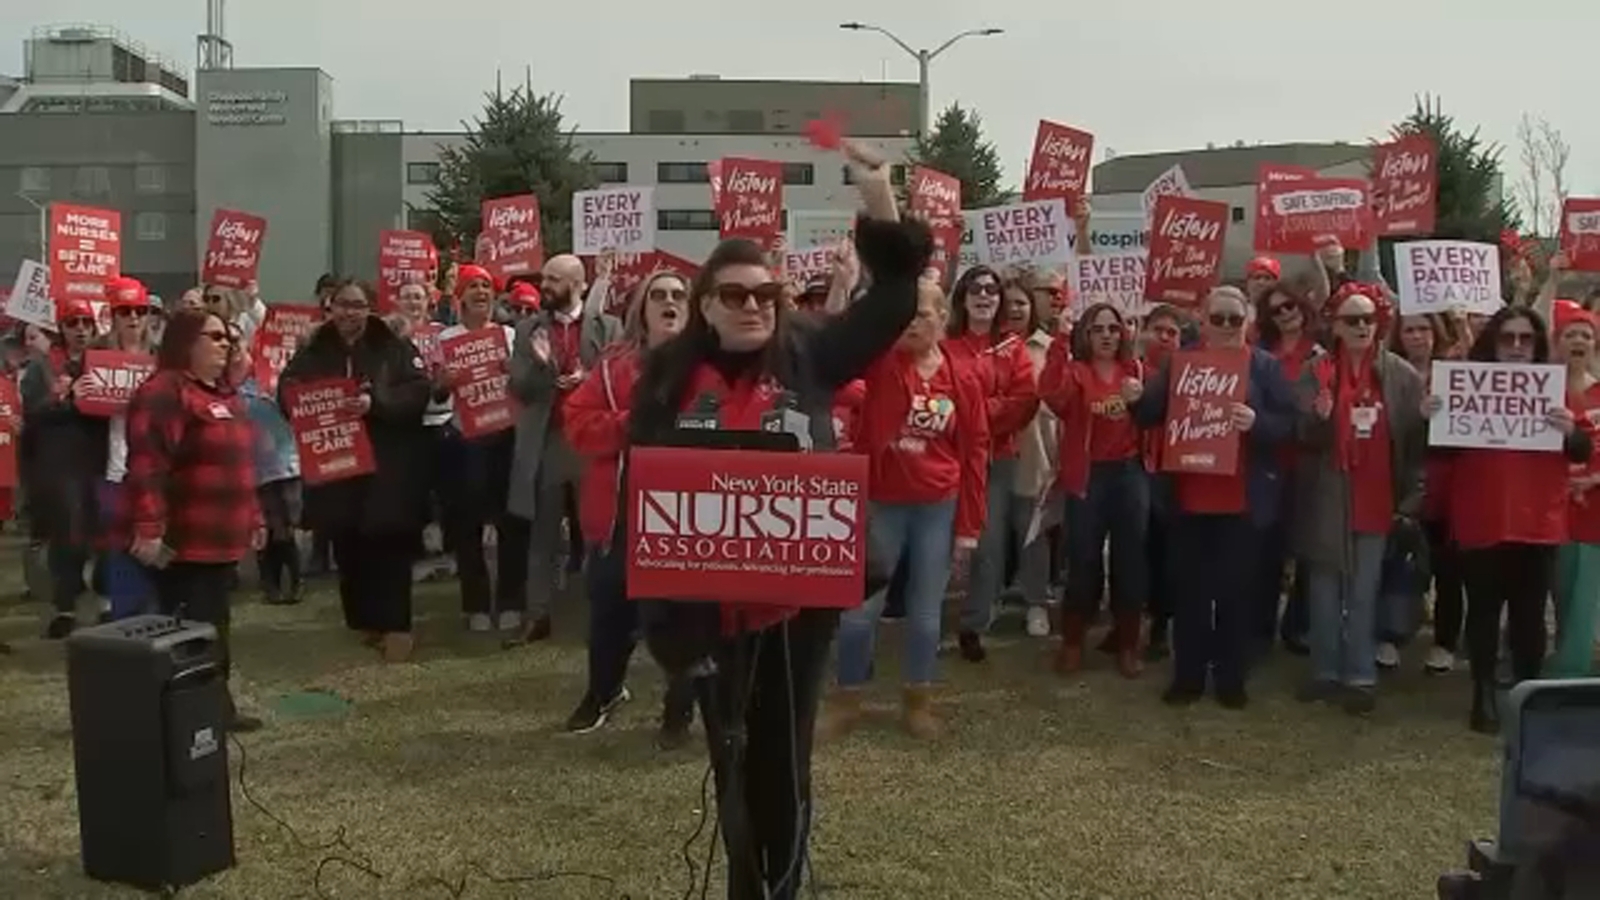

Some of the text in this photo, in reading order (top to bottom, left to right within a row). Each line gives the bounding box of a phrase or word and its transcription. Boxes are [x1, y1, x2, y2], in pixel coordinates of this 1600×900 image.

[584, 193, 641, 213] EVERY
[66, 213, 109, 228] MORE
[584, 212, 643, 230] PATIENT
[984, 205, 1053, 230] EVERY
[57, 223, 118, 241] NURSES
[612, 229, 642, 245] VIP
[987, 224, 1056, 245] PATIENT
[58, 249, 116, 265] BETTER
[989, 247, 1006, 263] IS
[1011, 244, 1022, 259] A
[1025, 240, 1058, 257] VIP
[1410, 246, 1488, 267] EVERY
[65, 261, 107, 276] CARE
[1414, 267, 1490, 285] PATIENT
[1080, 277, 1144, 293] PATIEN
[1415, 285, 1491, 303] IS A VIP
[454, 337, 496, 357] MORE
[1450, 369, 1550, 395] EVERY
[298, 388, 343, 403] MORE
[467, 390, 506, 407] CARE
[1449, 394, 1551, 416] PATIENT
[301, 421, 360, 443] BETTER
[1448, 415, 1548, 439] IS A VIP
[312, 435, 354, 454] CARE
[711, 473, 858, 497] New York State
[638, 490, 858, 543] NURSES
[636, 537, 857, 562] ASSOCIATION
[635, 558, 685, 571] Advocating
[687, 559, 699, 569] for
[741, 562, 787, 575] Advancing
